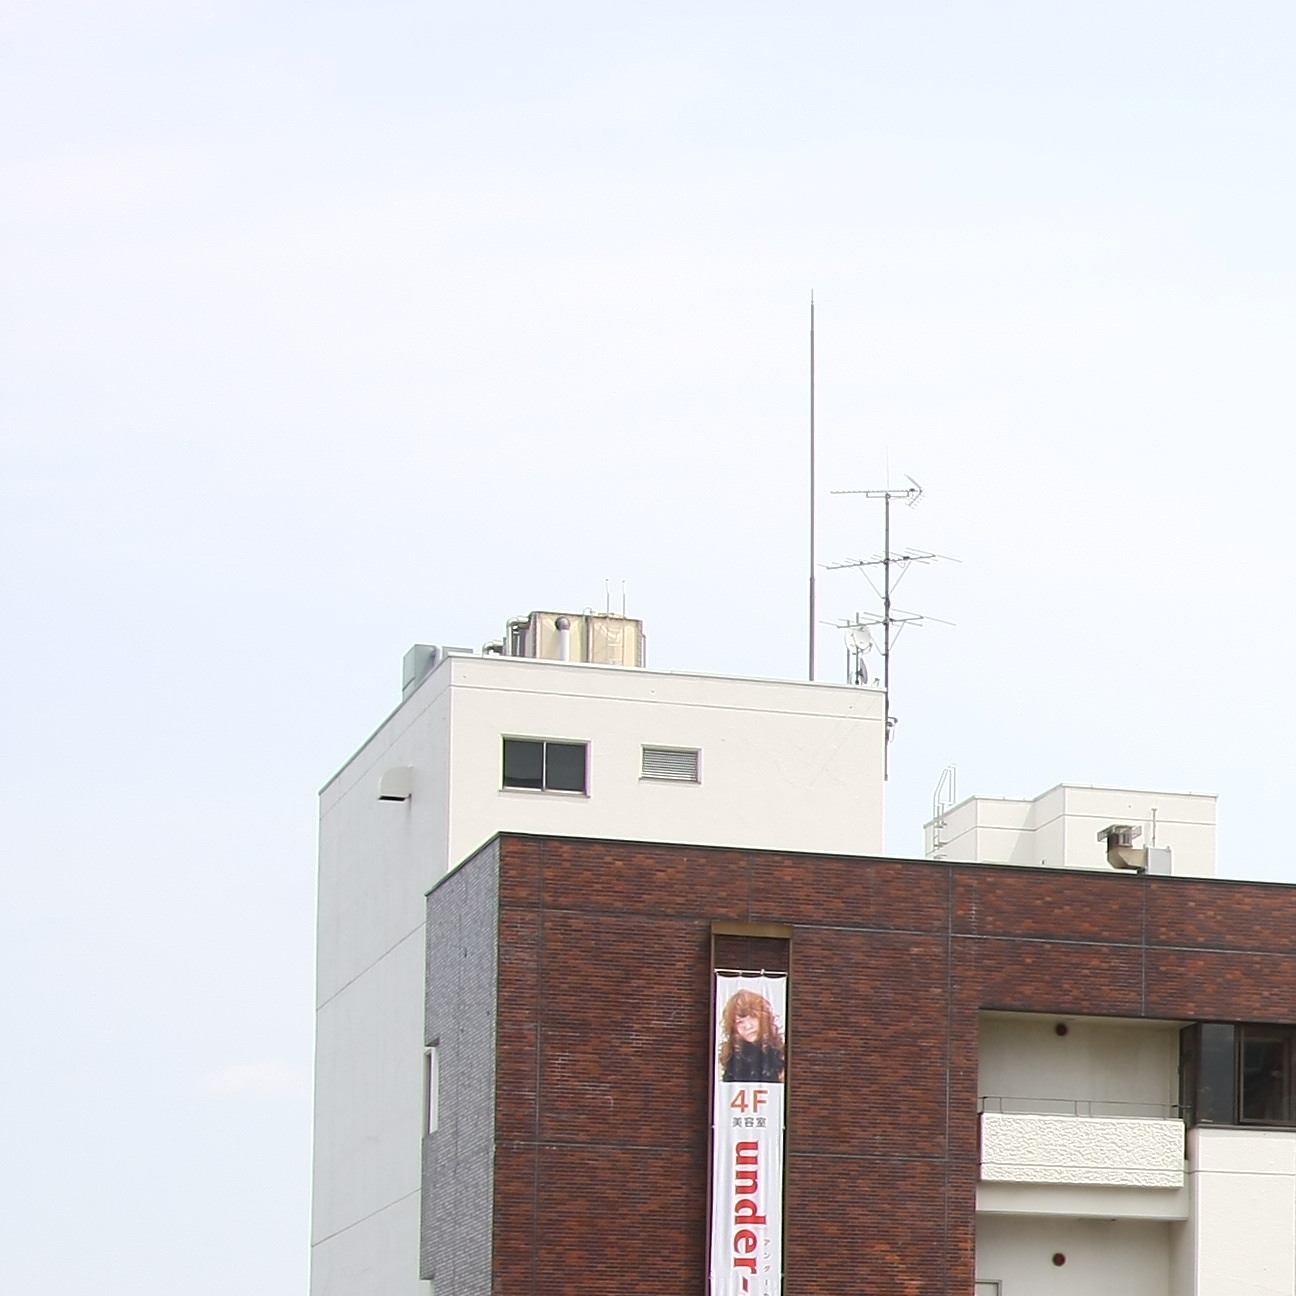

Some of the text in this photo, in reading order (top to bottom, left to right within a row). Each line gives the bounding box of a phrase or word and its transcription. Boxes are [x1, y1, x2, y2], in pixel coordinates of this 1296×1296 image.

[731, 1089, 768, 1114] 4F
[732, 1116, 766, 1128] 美容室
